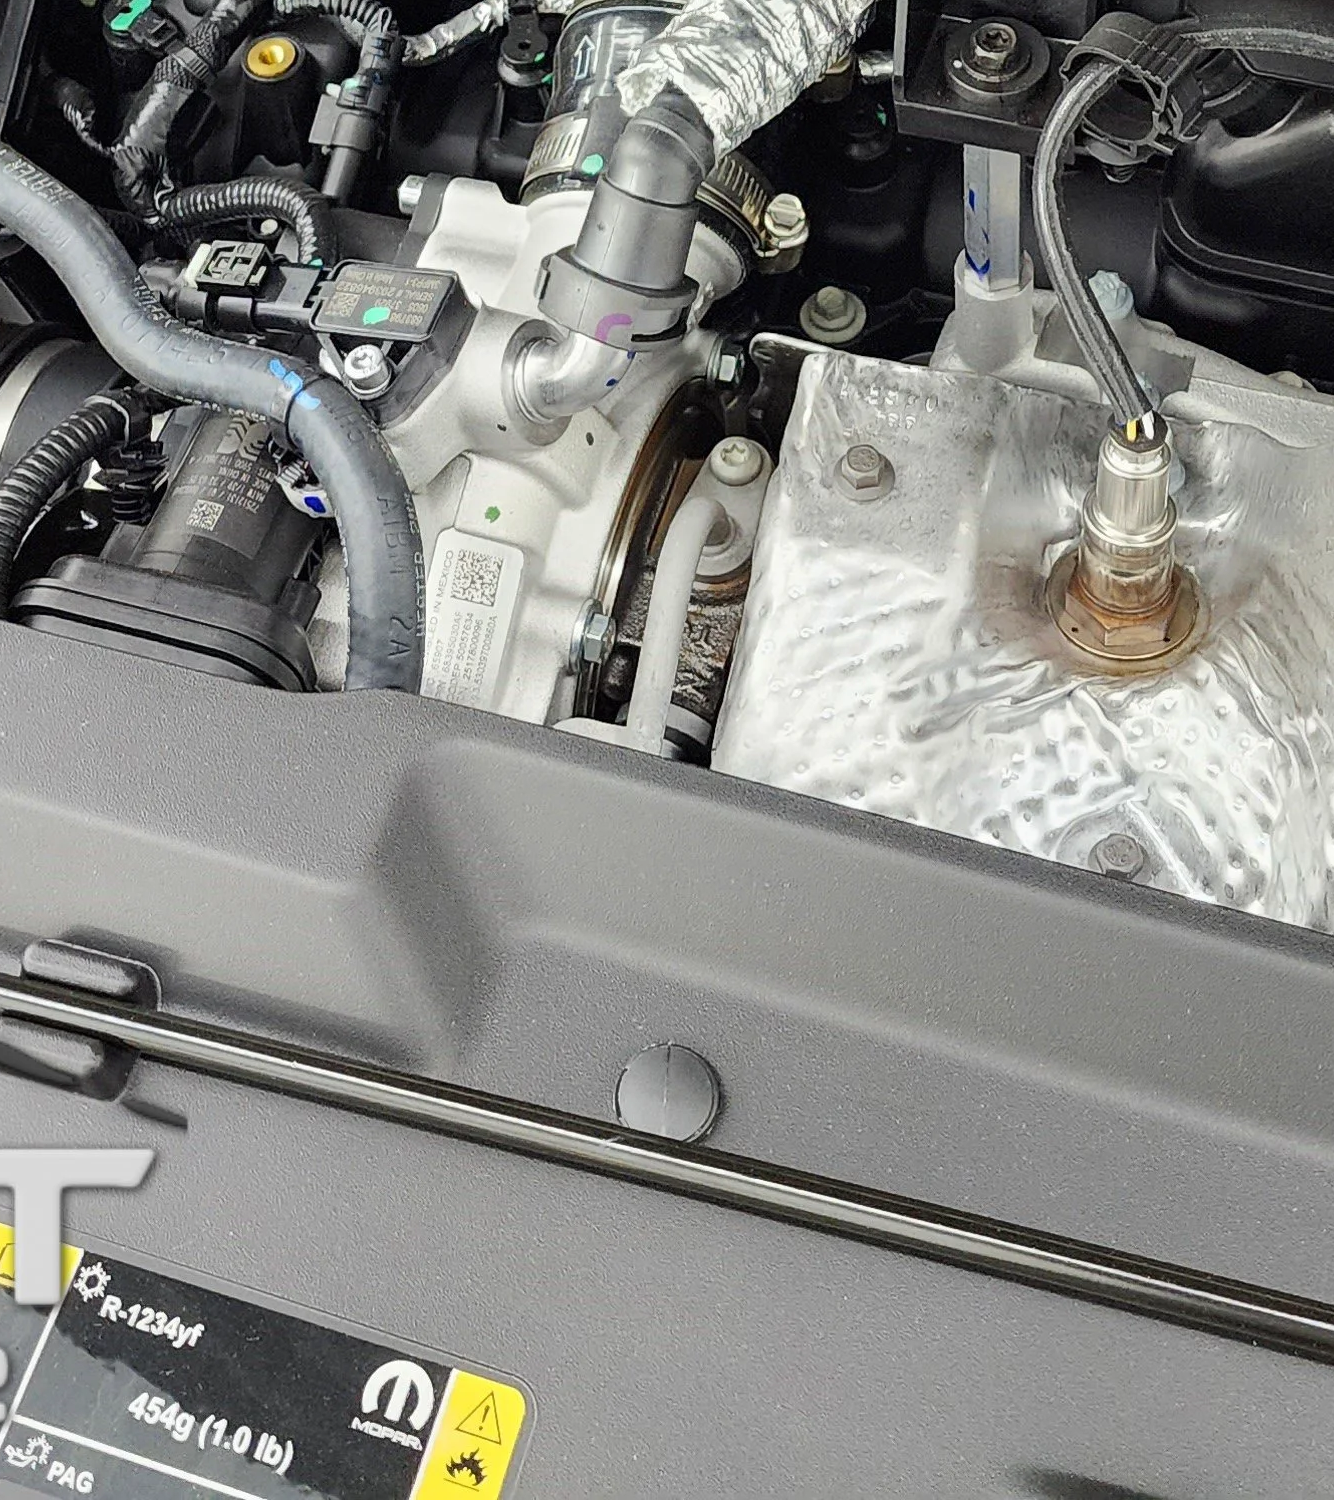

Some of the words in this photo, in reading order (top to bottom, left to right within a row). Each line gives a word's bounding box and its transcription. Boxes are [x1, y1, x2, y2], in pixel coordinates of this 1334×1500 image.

[438, 550, 454, 598] MEXICO
[97, 1294, 205, 1350] R-1234yf
[126, 1392, 197, 1443] 454g
[197, 1413, 253, 1457] (1.0
[252, 1432, 295, 1476] lb)
[348, 1416, 424, 1452] MOPAR
[45, 1458, 95, 1495] PAG
